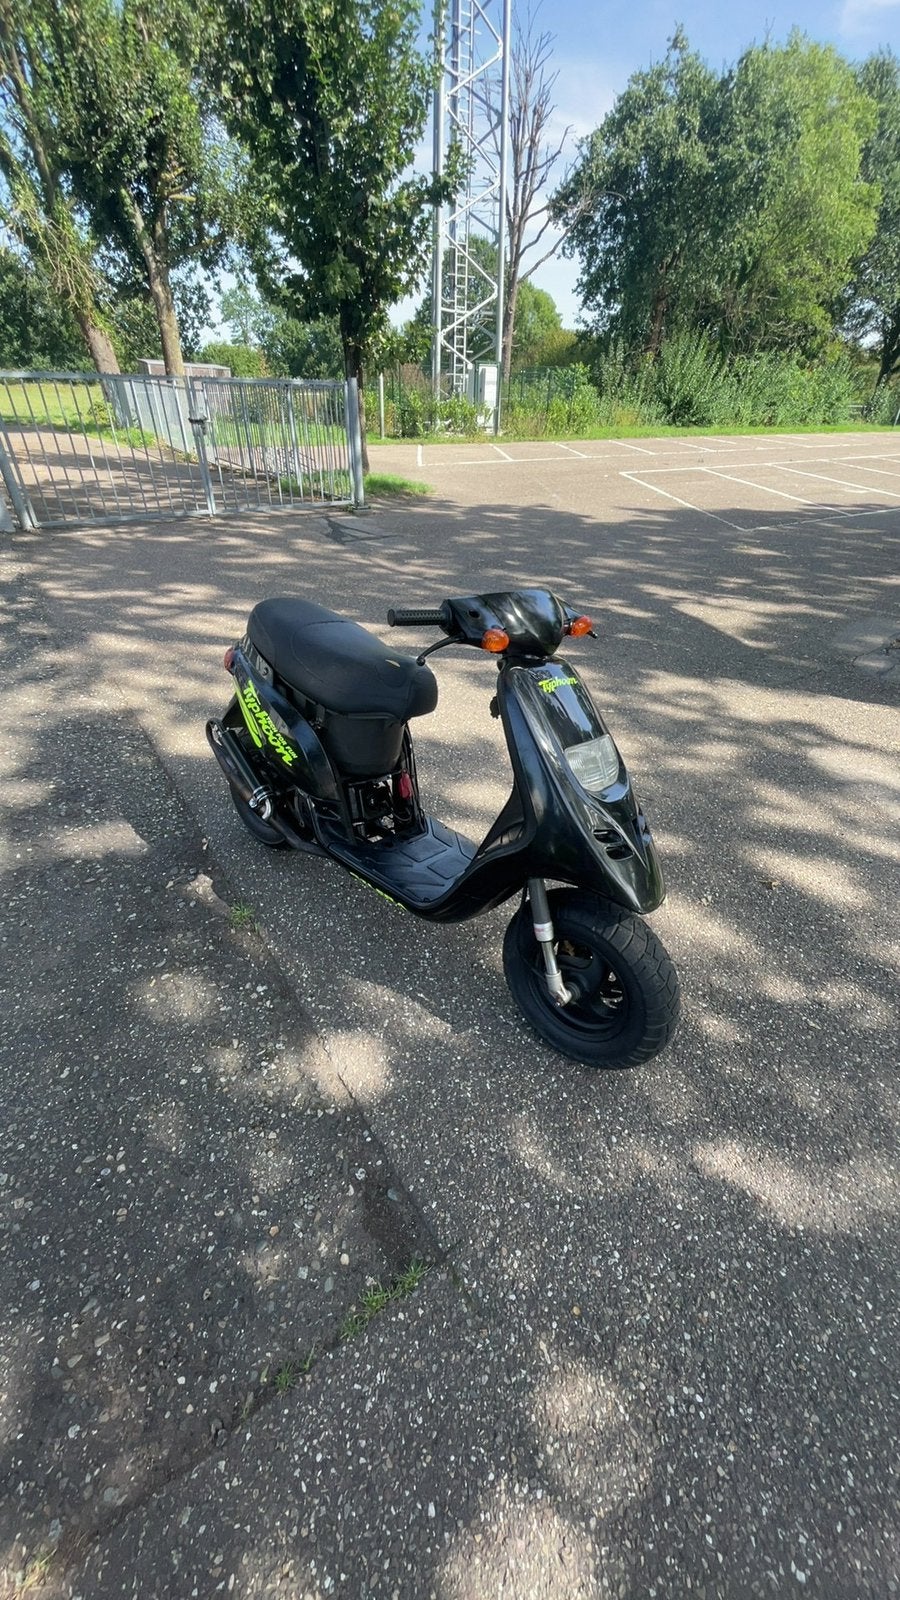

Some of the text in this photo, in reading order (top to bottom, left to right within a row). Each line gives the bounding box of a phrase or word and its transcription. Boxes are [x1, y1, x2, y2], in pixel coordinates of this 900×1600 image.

[538, 676, 578, 693] Typhoon
[243, 679, 293, 767] Typhoon
[276, 733, 287, 746] FOR
[285, 745, 298, 759] FUN
